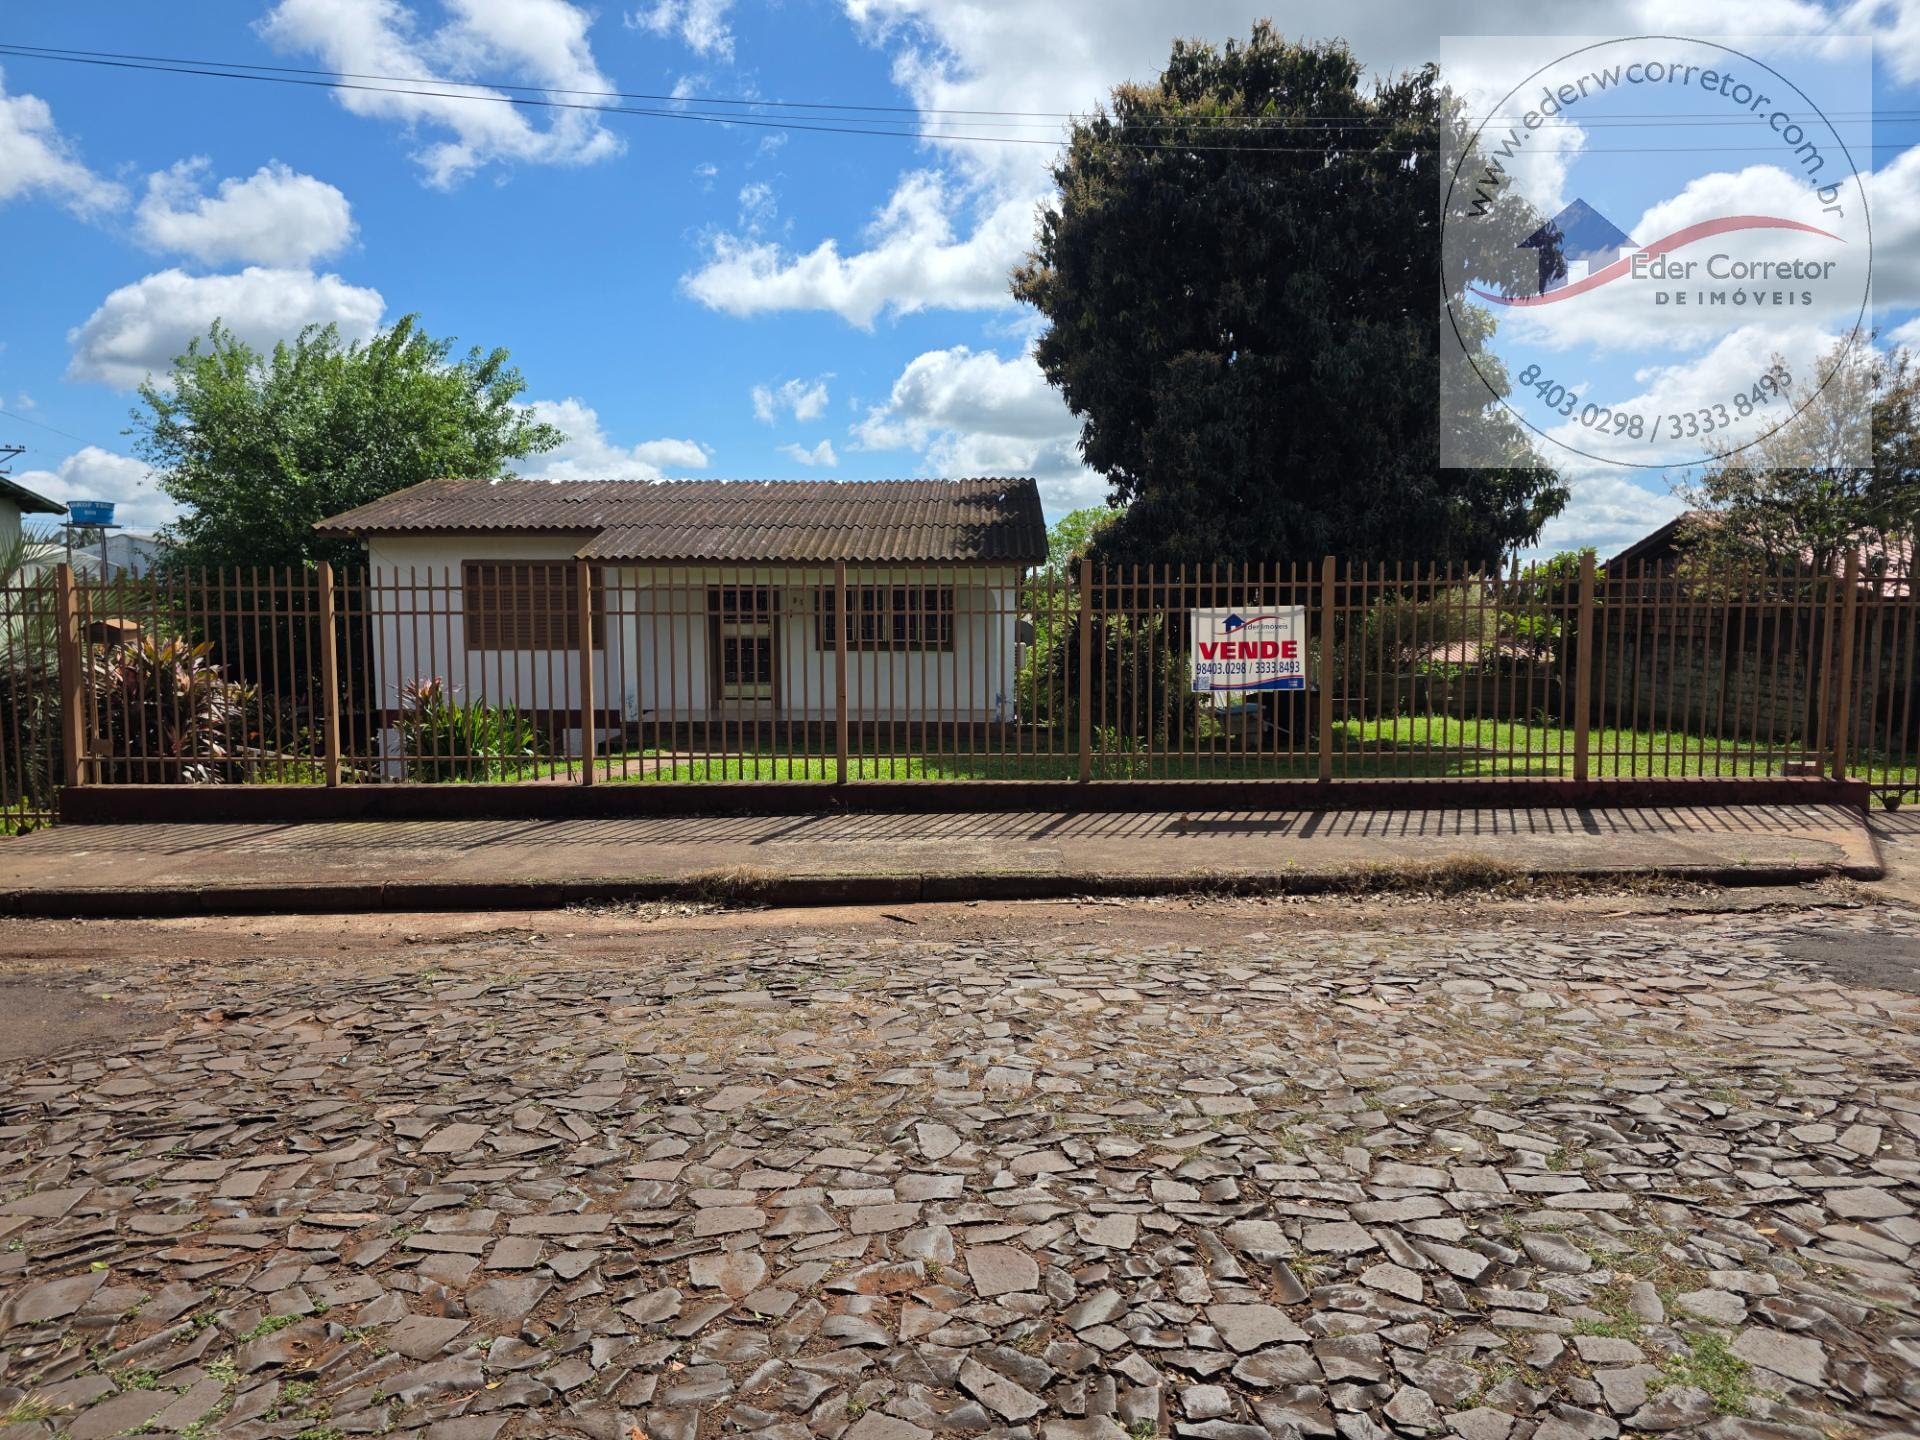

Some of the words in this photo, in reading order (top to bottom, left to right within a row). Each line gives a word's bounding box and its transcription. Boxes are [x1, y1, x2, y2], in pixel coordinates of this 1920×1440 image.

[1199, 640, 1298, 660] VENDE
[1196, 662, 1246, 675] 98403.0298
[1255, 661, 1300, 674] 3333.8493
